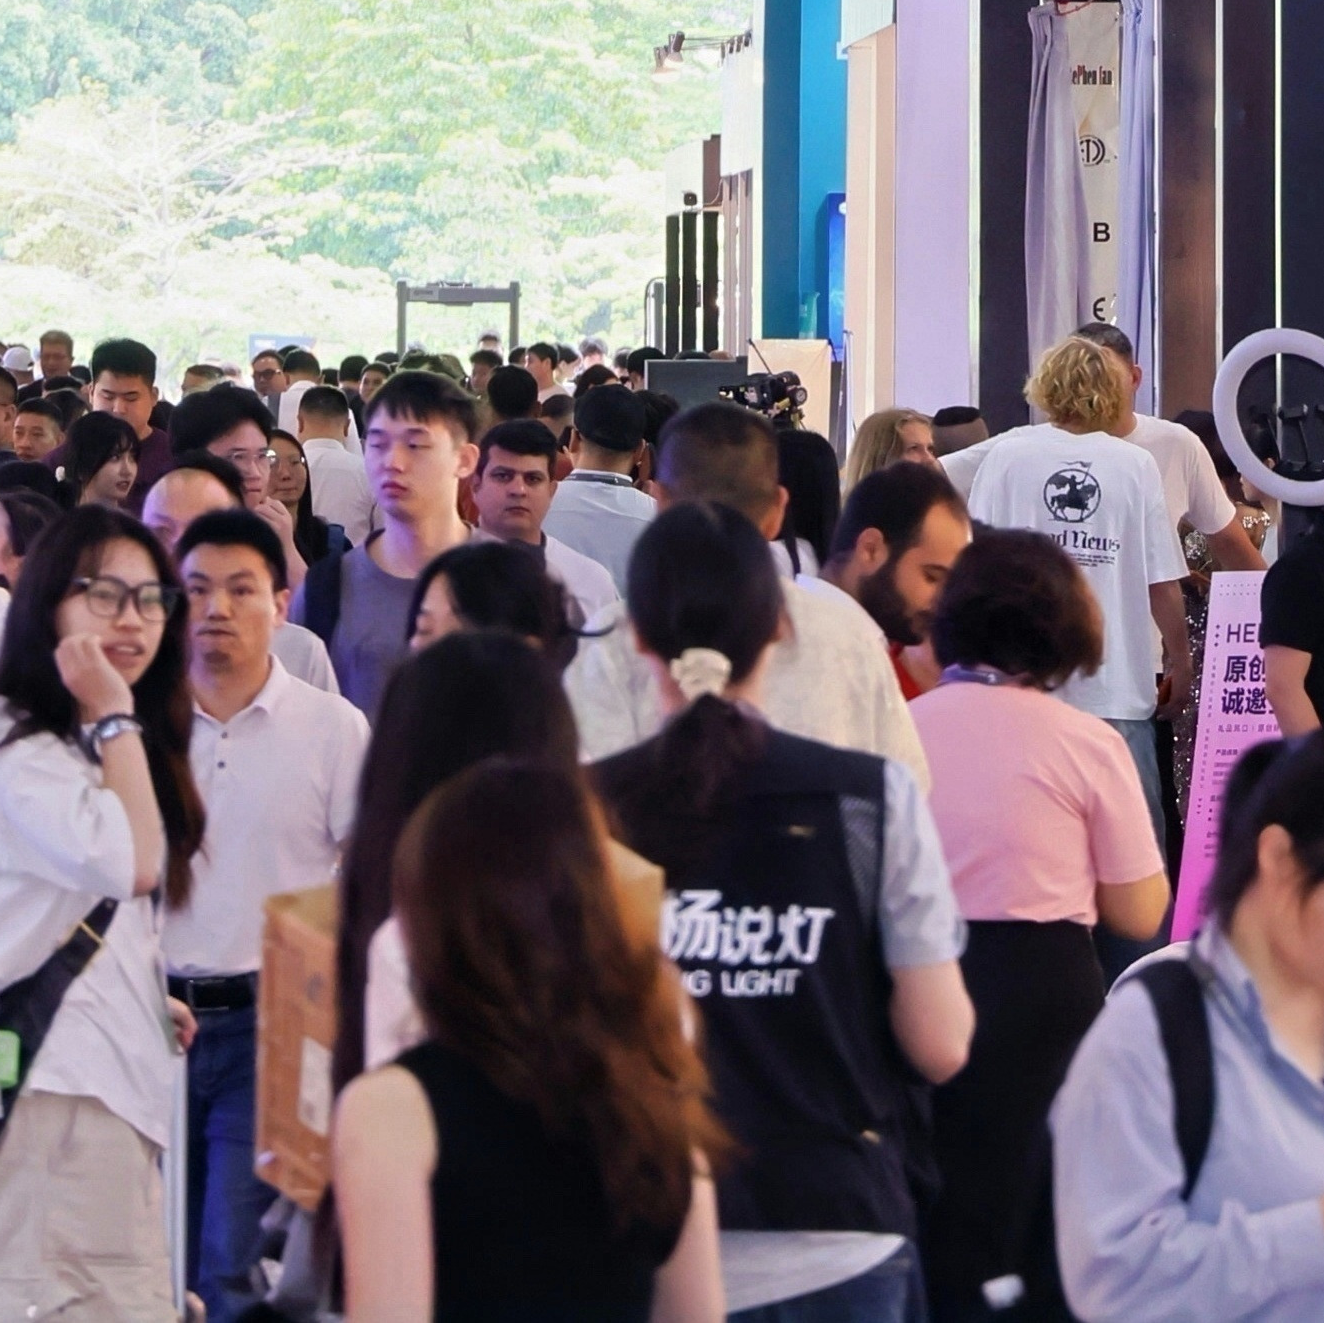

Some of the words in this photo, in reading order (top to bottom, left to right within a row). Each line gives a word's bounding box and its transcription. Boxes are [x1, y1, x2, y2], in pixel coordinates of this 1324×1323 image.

[1093, 222, 1110, 242] B
[1221, 688, 1275, 715] 诚邀
[721, 970, 801, 996] LIGHT
